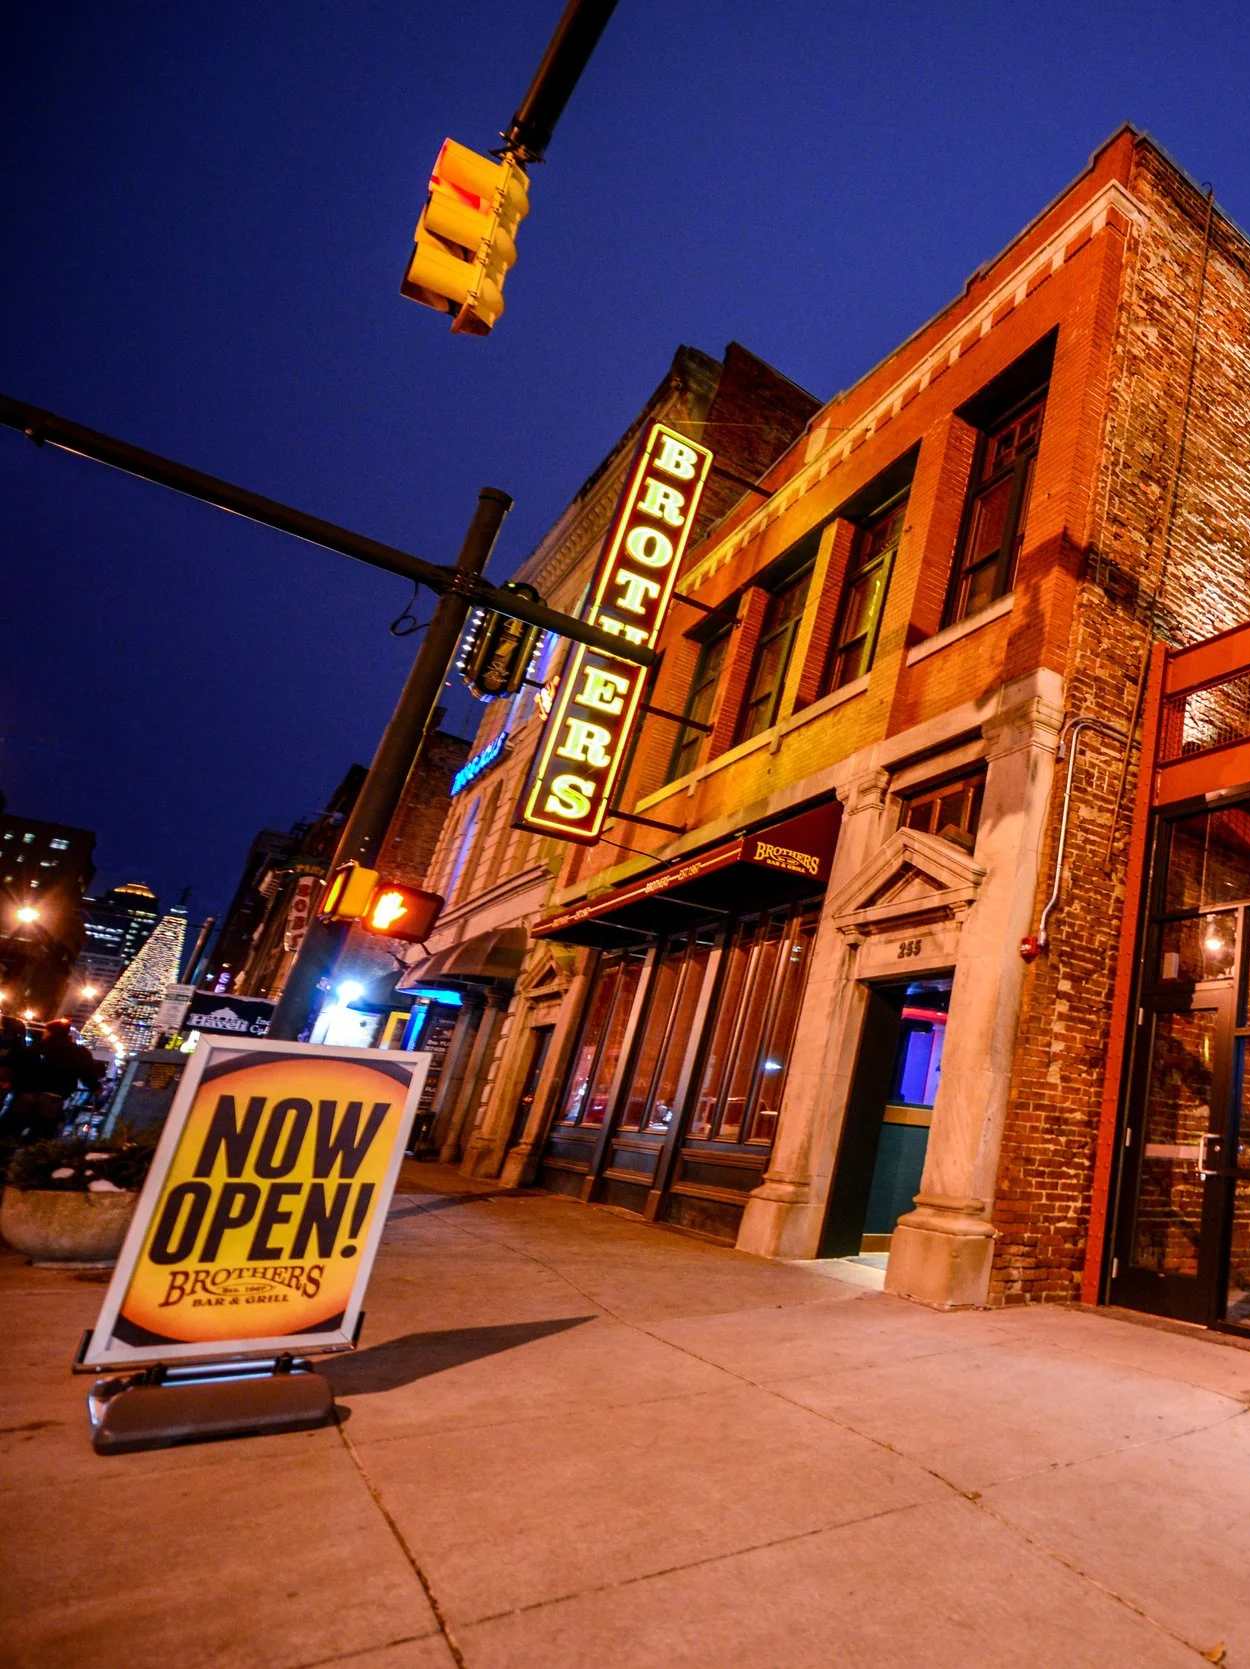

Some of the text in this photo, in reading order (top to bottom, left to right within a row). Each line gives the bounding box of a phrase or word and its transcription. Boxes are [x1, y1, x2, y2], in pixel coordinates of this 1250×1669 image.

[753, 841, 820, 875] BROTHERS
[897, 938, 922, 959] 255
[192, 1094, 392, 1179] NOW
[147, 1181, 376, 1265] OPEN!
[158, 1264, 325, 1308] BROTHERS
[192, 1294, 290, 1308] BAR & GRILL
